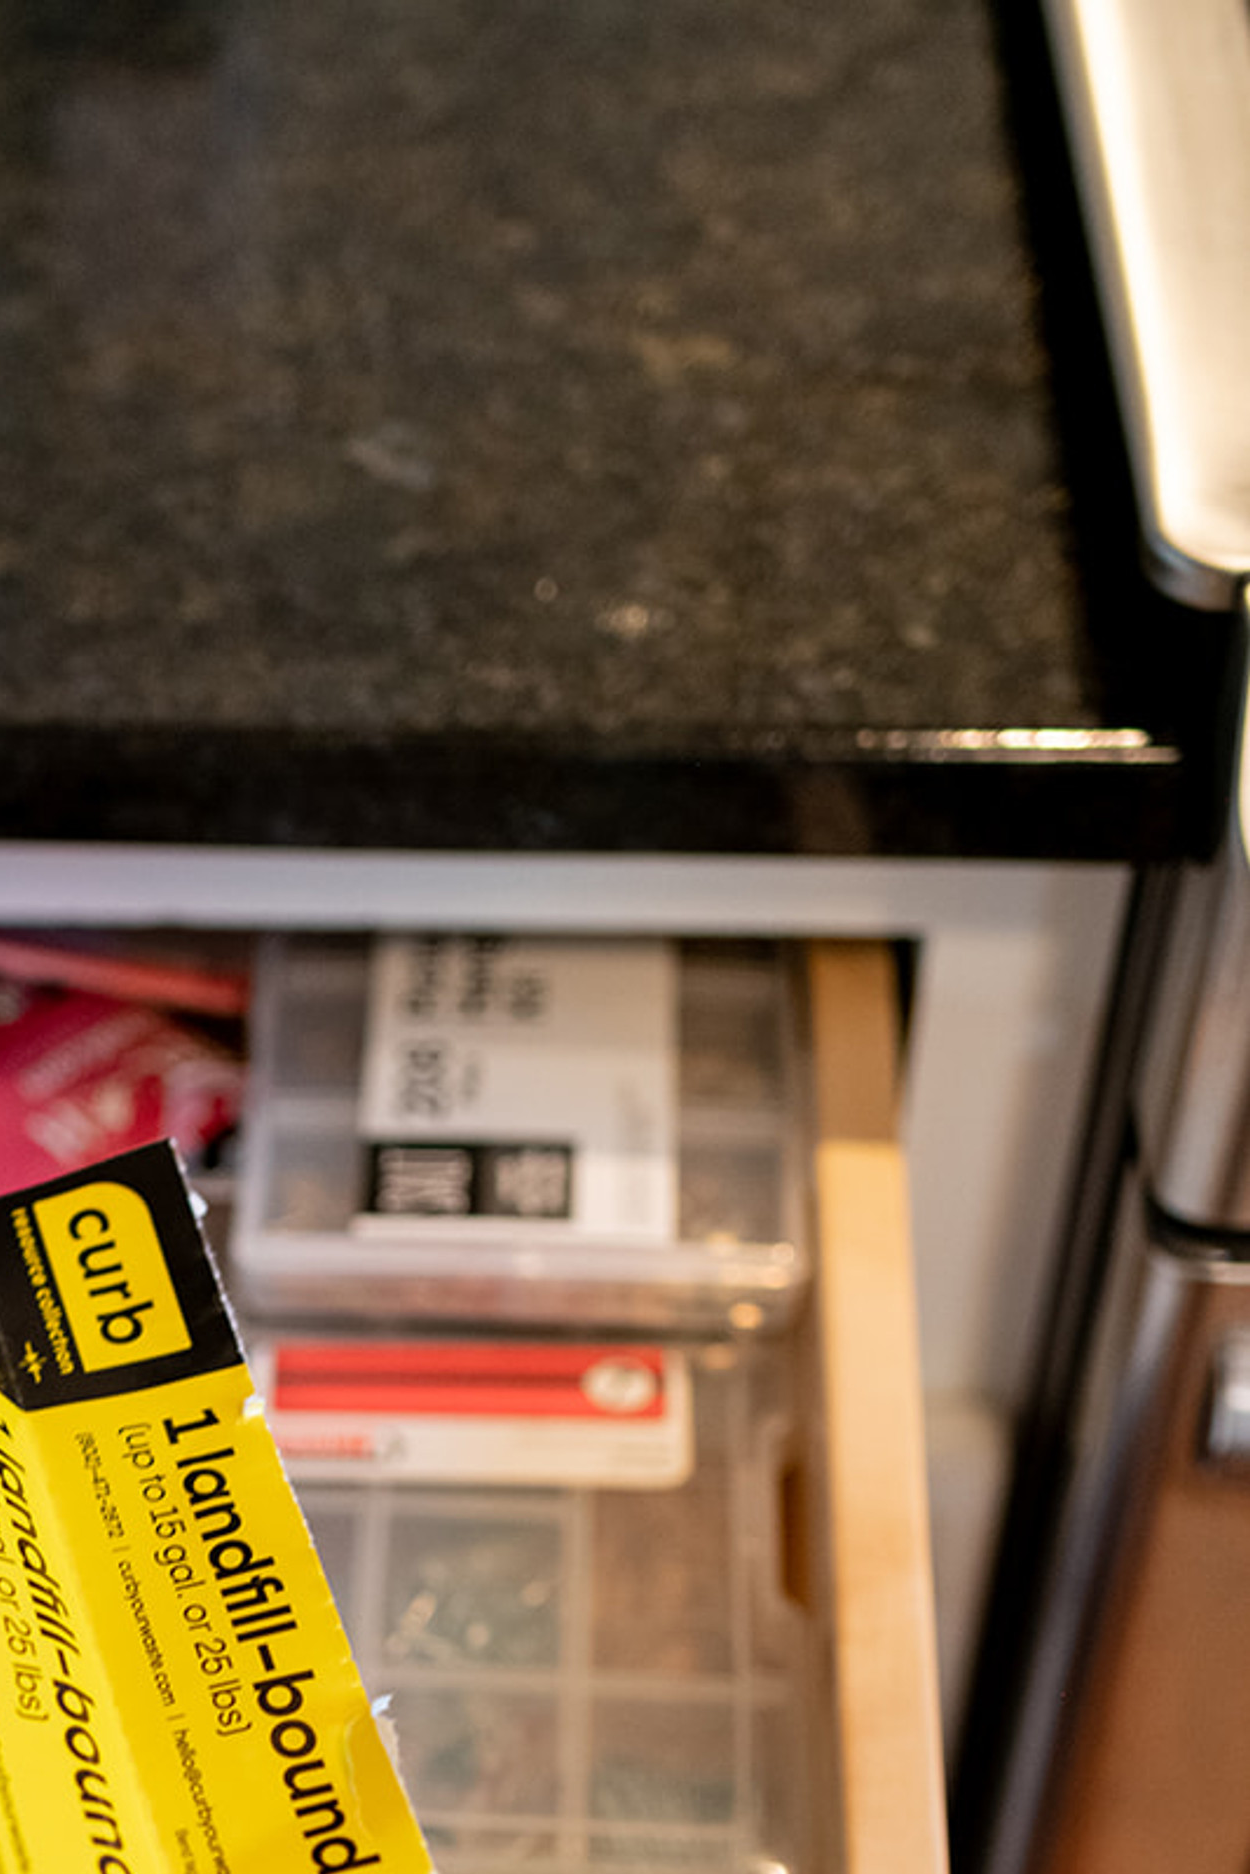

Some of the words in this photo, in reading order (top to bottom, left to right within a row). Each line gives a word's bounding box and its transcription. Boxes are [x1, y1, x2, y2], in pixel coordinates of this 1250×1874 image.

[10, 1206, 48, 1287] resource
[35, 1286, 76, 1376] collection
[68, 1207, 154, 1345] curb
[117, 1422, 156, 1470] (up
[162, 1408, 220, 1445] 1
[139, 1473, 167, 1503] to
[149, 1505, 187, 1539] 15
[153, 1544, 206, 1599] gal.
[2, 1615, 37, 1656] 25
[117, 1560, 176, 1707] curbyourwaste.com
[182, 1603, 213, 1632] or
[193, 1637, 234, 1676] 25
[208, 1678, 253, 1737] lbs)
